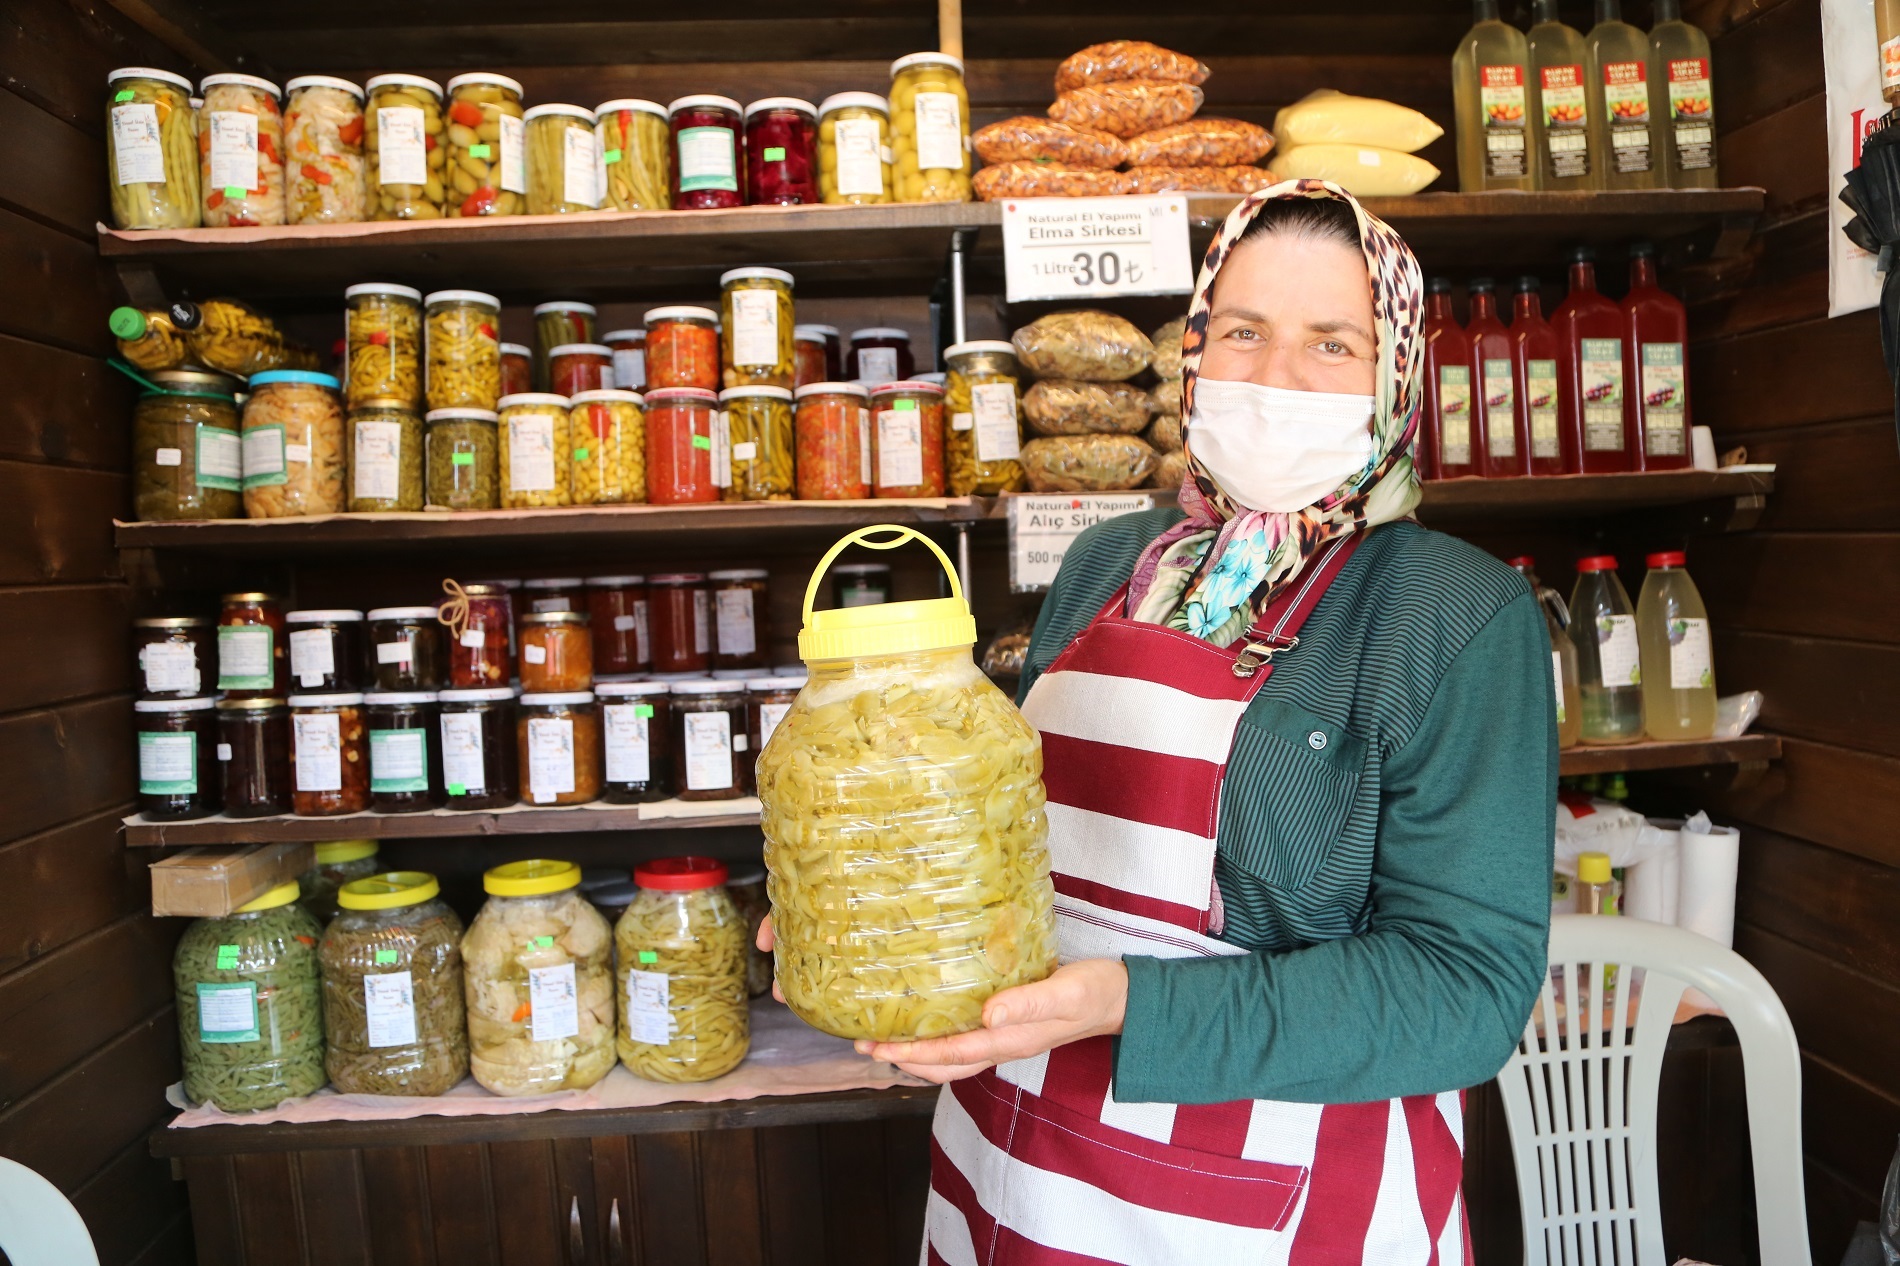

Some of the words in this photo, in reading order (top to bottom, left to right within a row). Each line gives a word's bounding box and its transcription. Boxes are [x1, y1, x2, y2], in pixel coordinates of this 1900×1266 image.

[1028, 213, 1077, 223] Natural
[1082, 212, 1093, 222] El
[1097, 212, 1142, 222] Yapımı
[1029, 226, 1074, 239] Elma
[1081, 223, 1142, 237] Sirkesi
[1032, 263, 1039, 275] 1
[1044, 261, 1077, 275] Litre
[1026, 501, 1076, 510] Natura
[1080, 501, 1091, 510] El
[1029, 514, 1064, 530] Alıç
[1072, 513, 1110, 527] Sirk
[1028, 551, 1049, 564] 500
[1053, 551, 1067, 563] m
